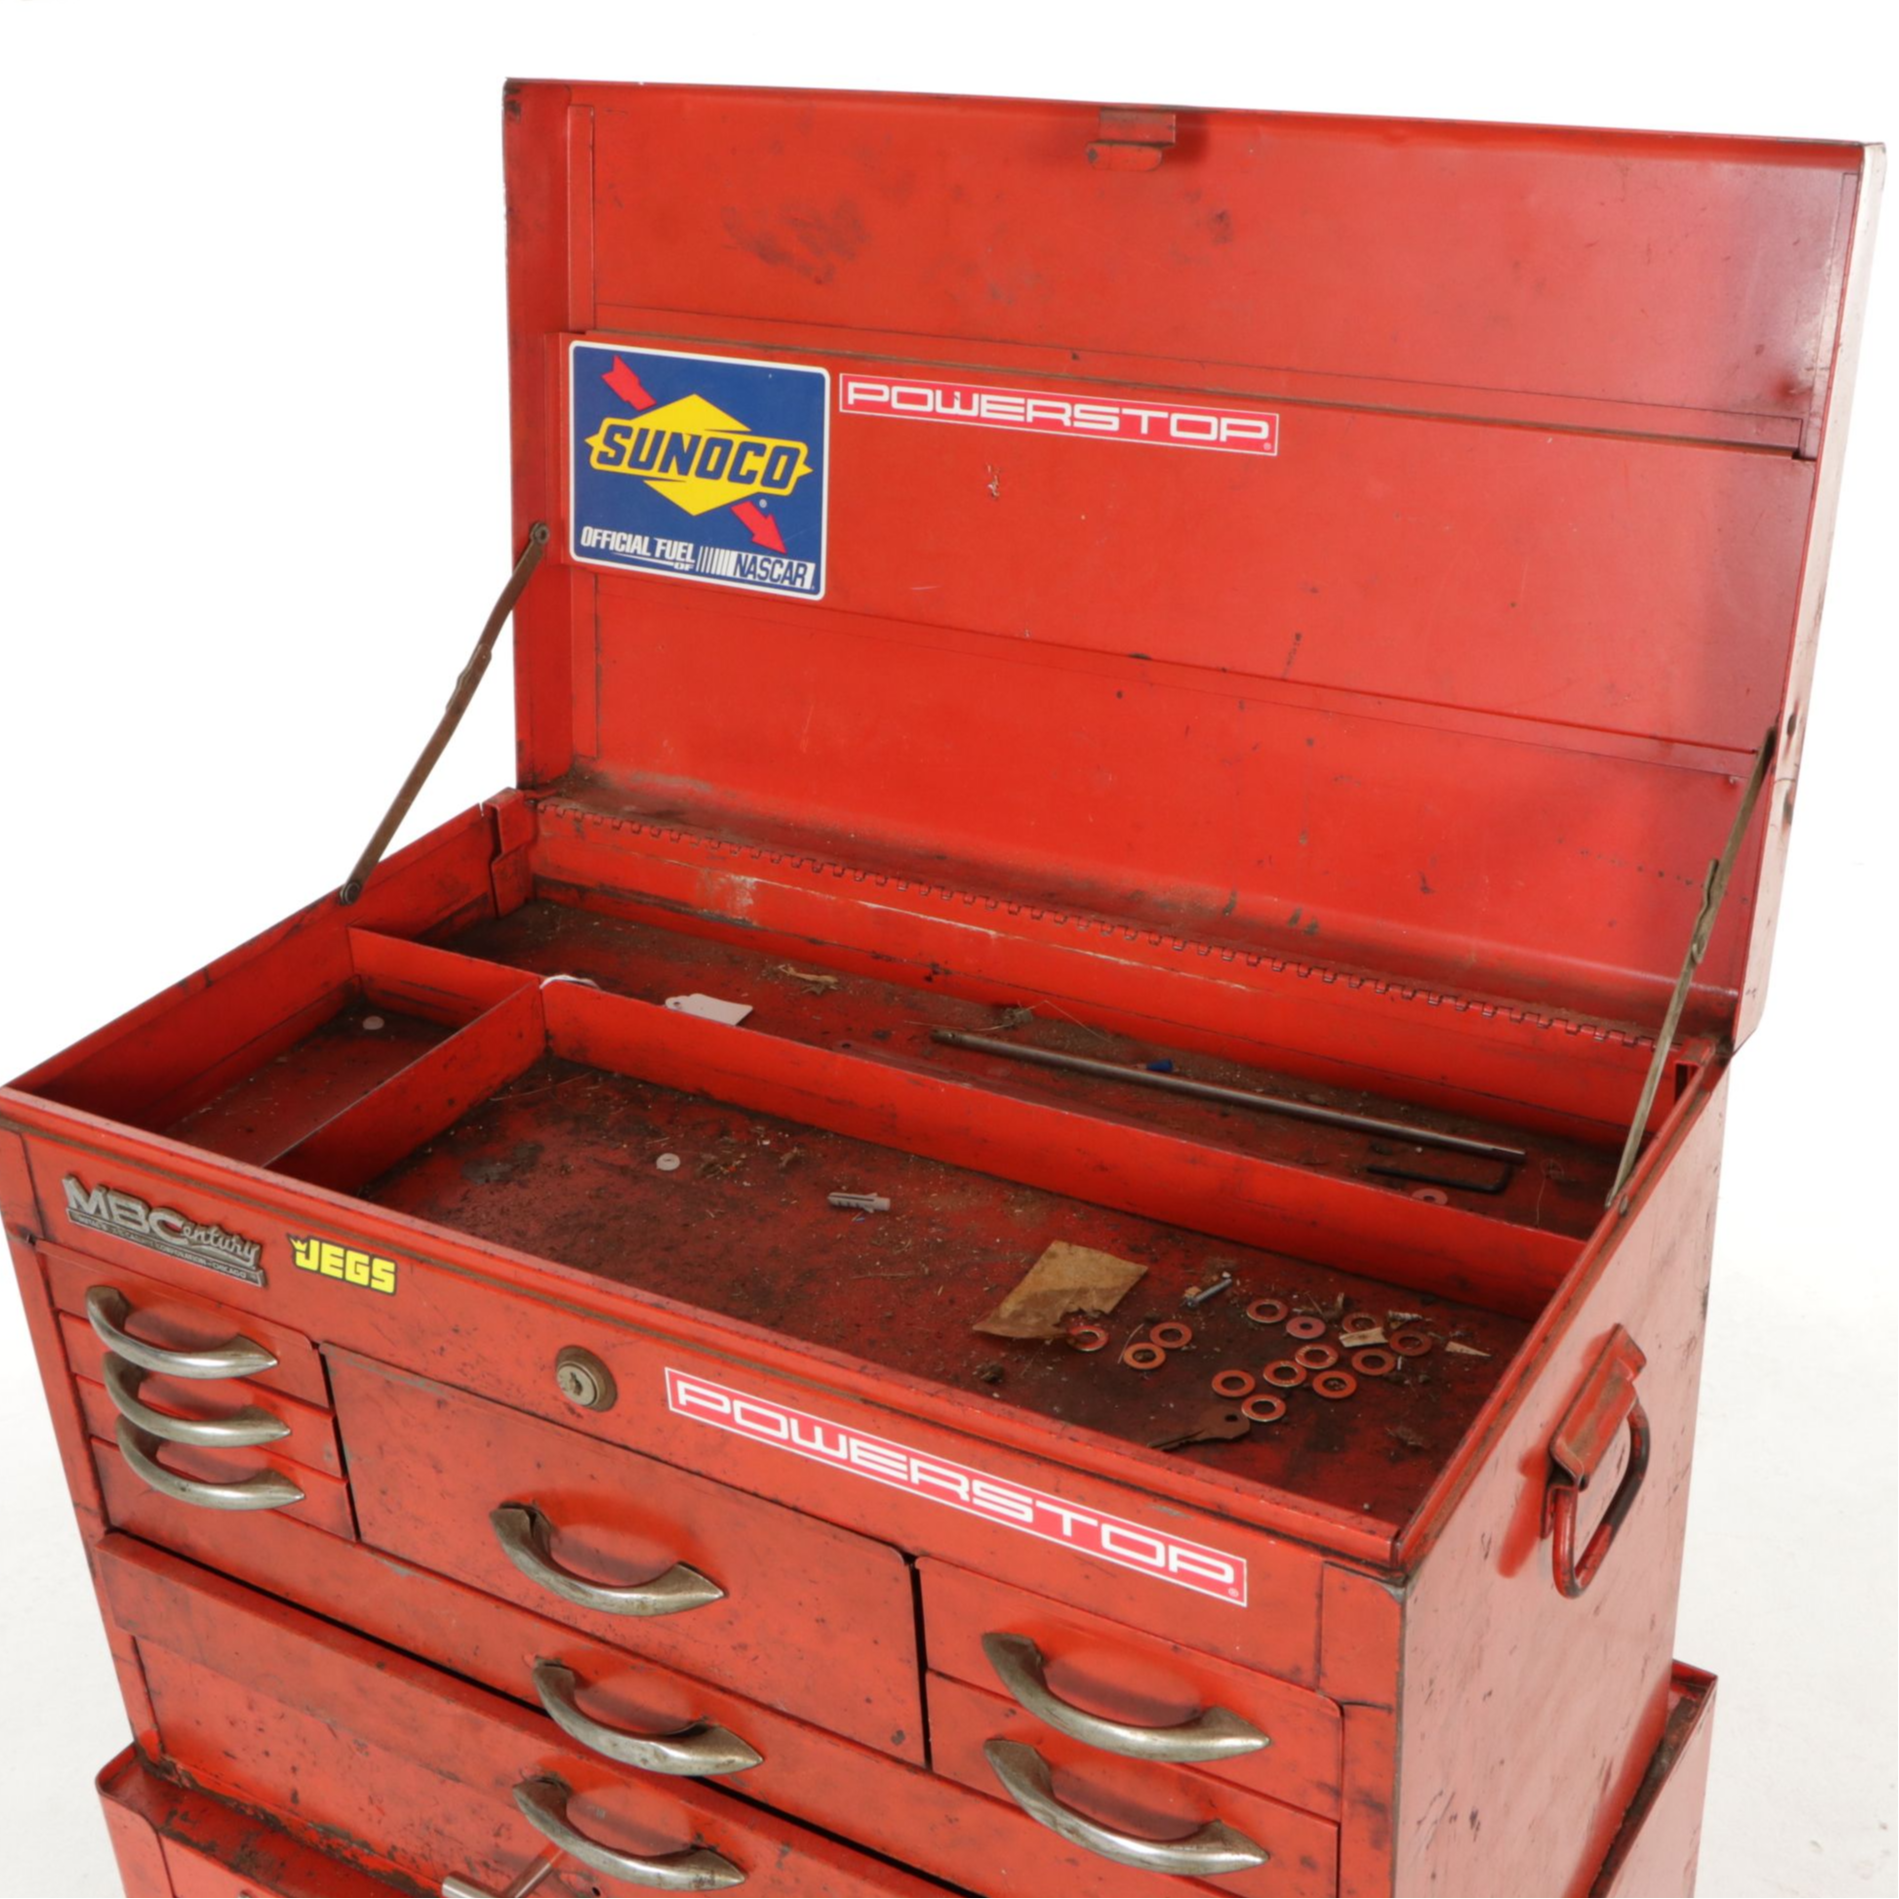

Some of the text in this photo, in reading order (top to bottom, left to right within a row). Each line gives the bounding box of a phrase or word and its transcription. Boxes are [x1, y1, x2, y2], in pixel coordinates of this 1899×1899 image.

[847, 381, 1269, 442] POWERSTOP
[596, 423, 801, 490] SUNOCO
[580, 526, 696, 564] OFFICIAL FUEL
[673, 561, 694, 572] OF
[733, 551, 807, 588] NASCAR
[293, 1238, 396, 1295] JEGS
[677, 1379, 1234, 1586] POWERSTOP
